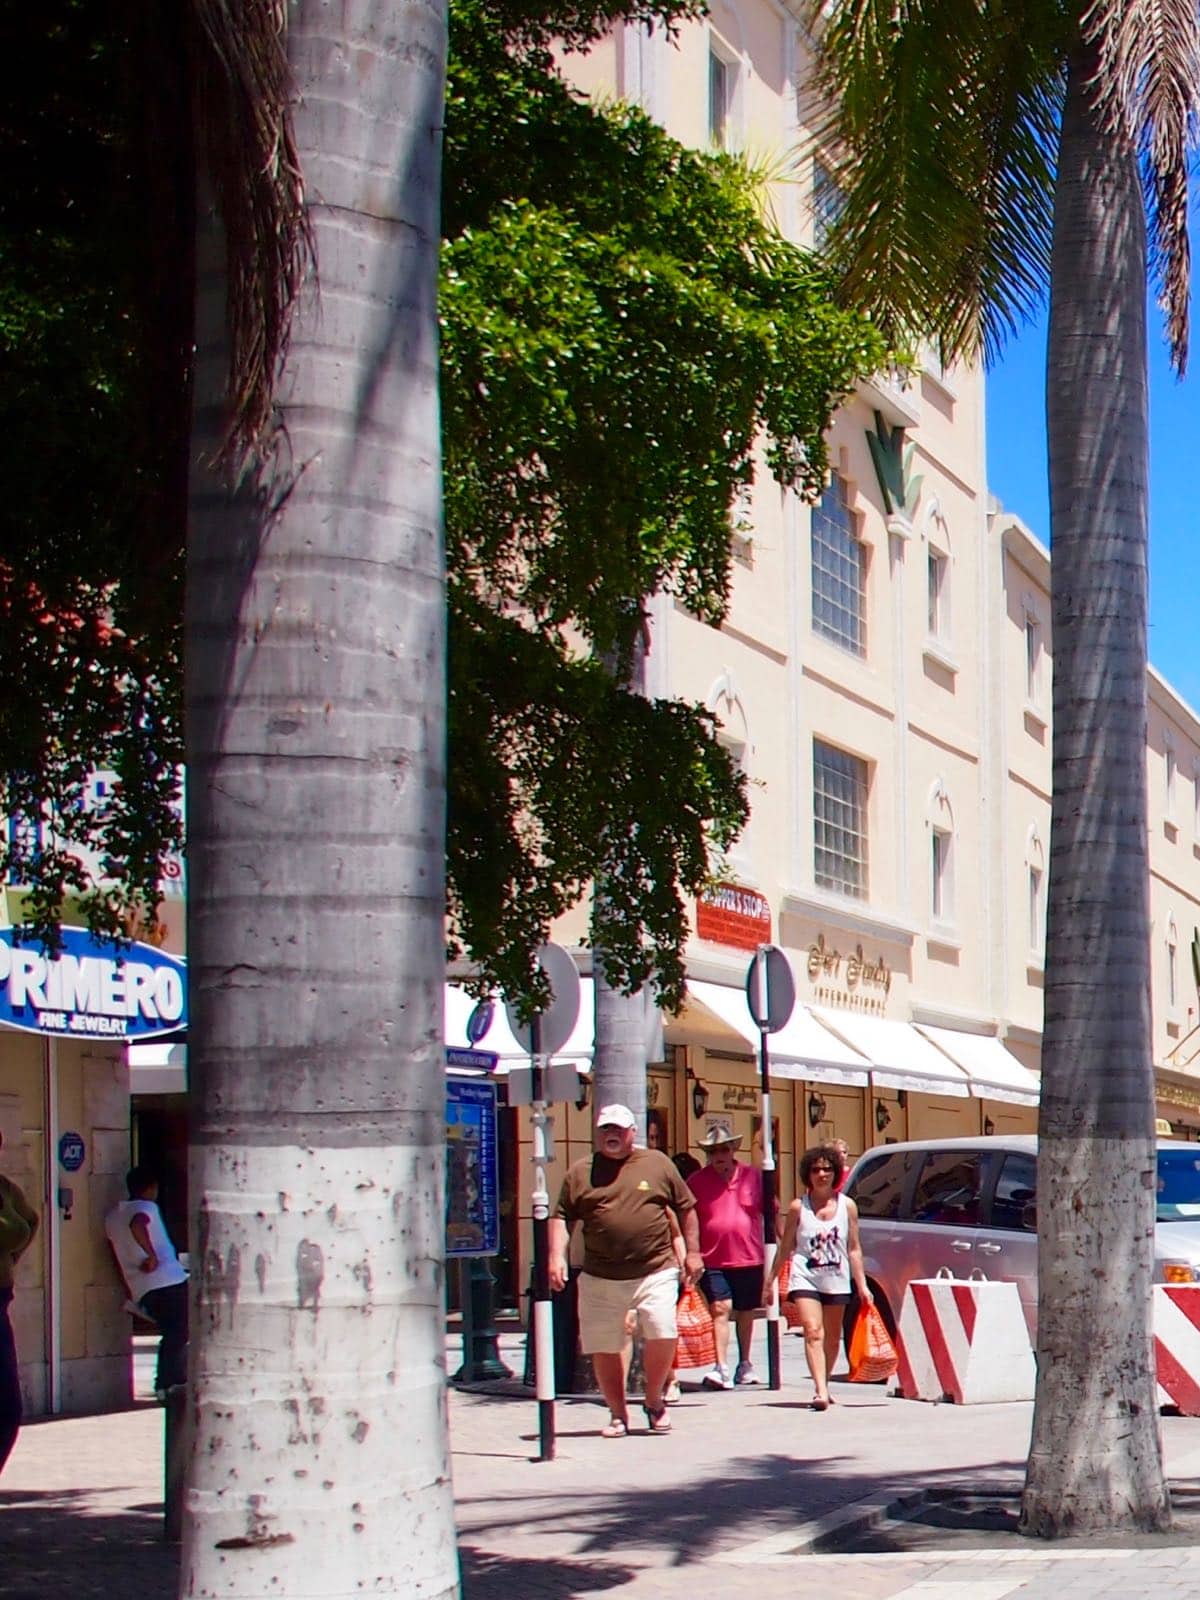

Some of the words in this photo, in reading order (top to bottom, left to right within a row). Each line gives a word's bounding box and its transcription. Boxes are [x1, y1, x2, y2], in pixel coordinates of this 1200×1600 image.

[743, 894, 763, 918] STOP
[39, 1012, 67, 1028] FINE
[70, 1015, 127, 1034] JEWELRY
[63, 1143, 82, 1159] ADT
